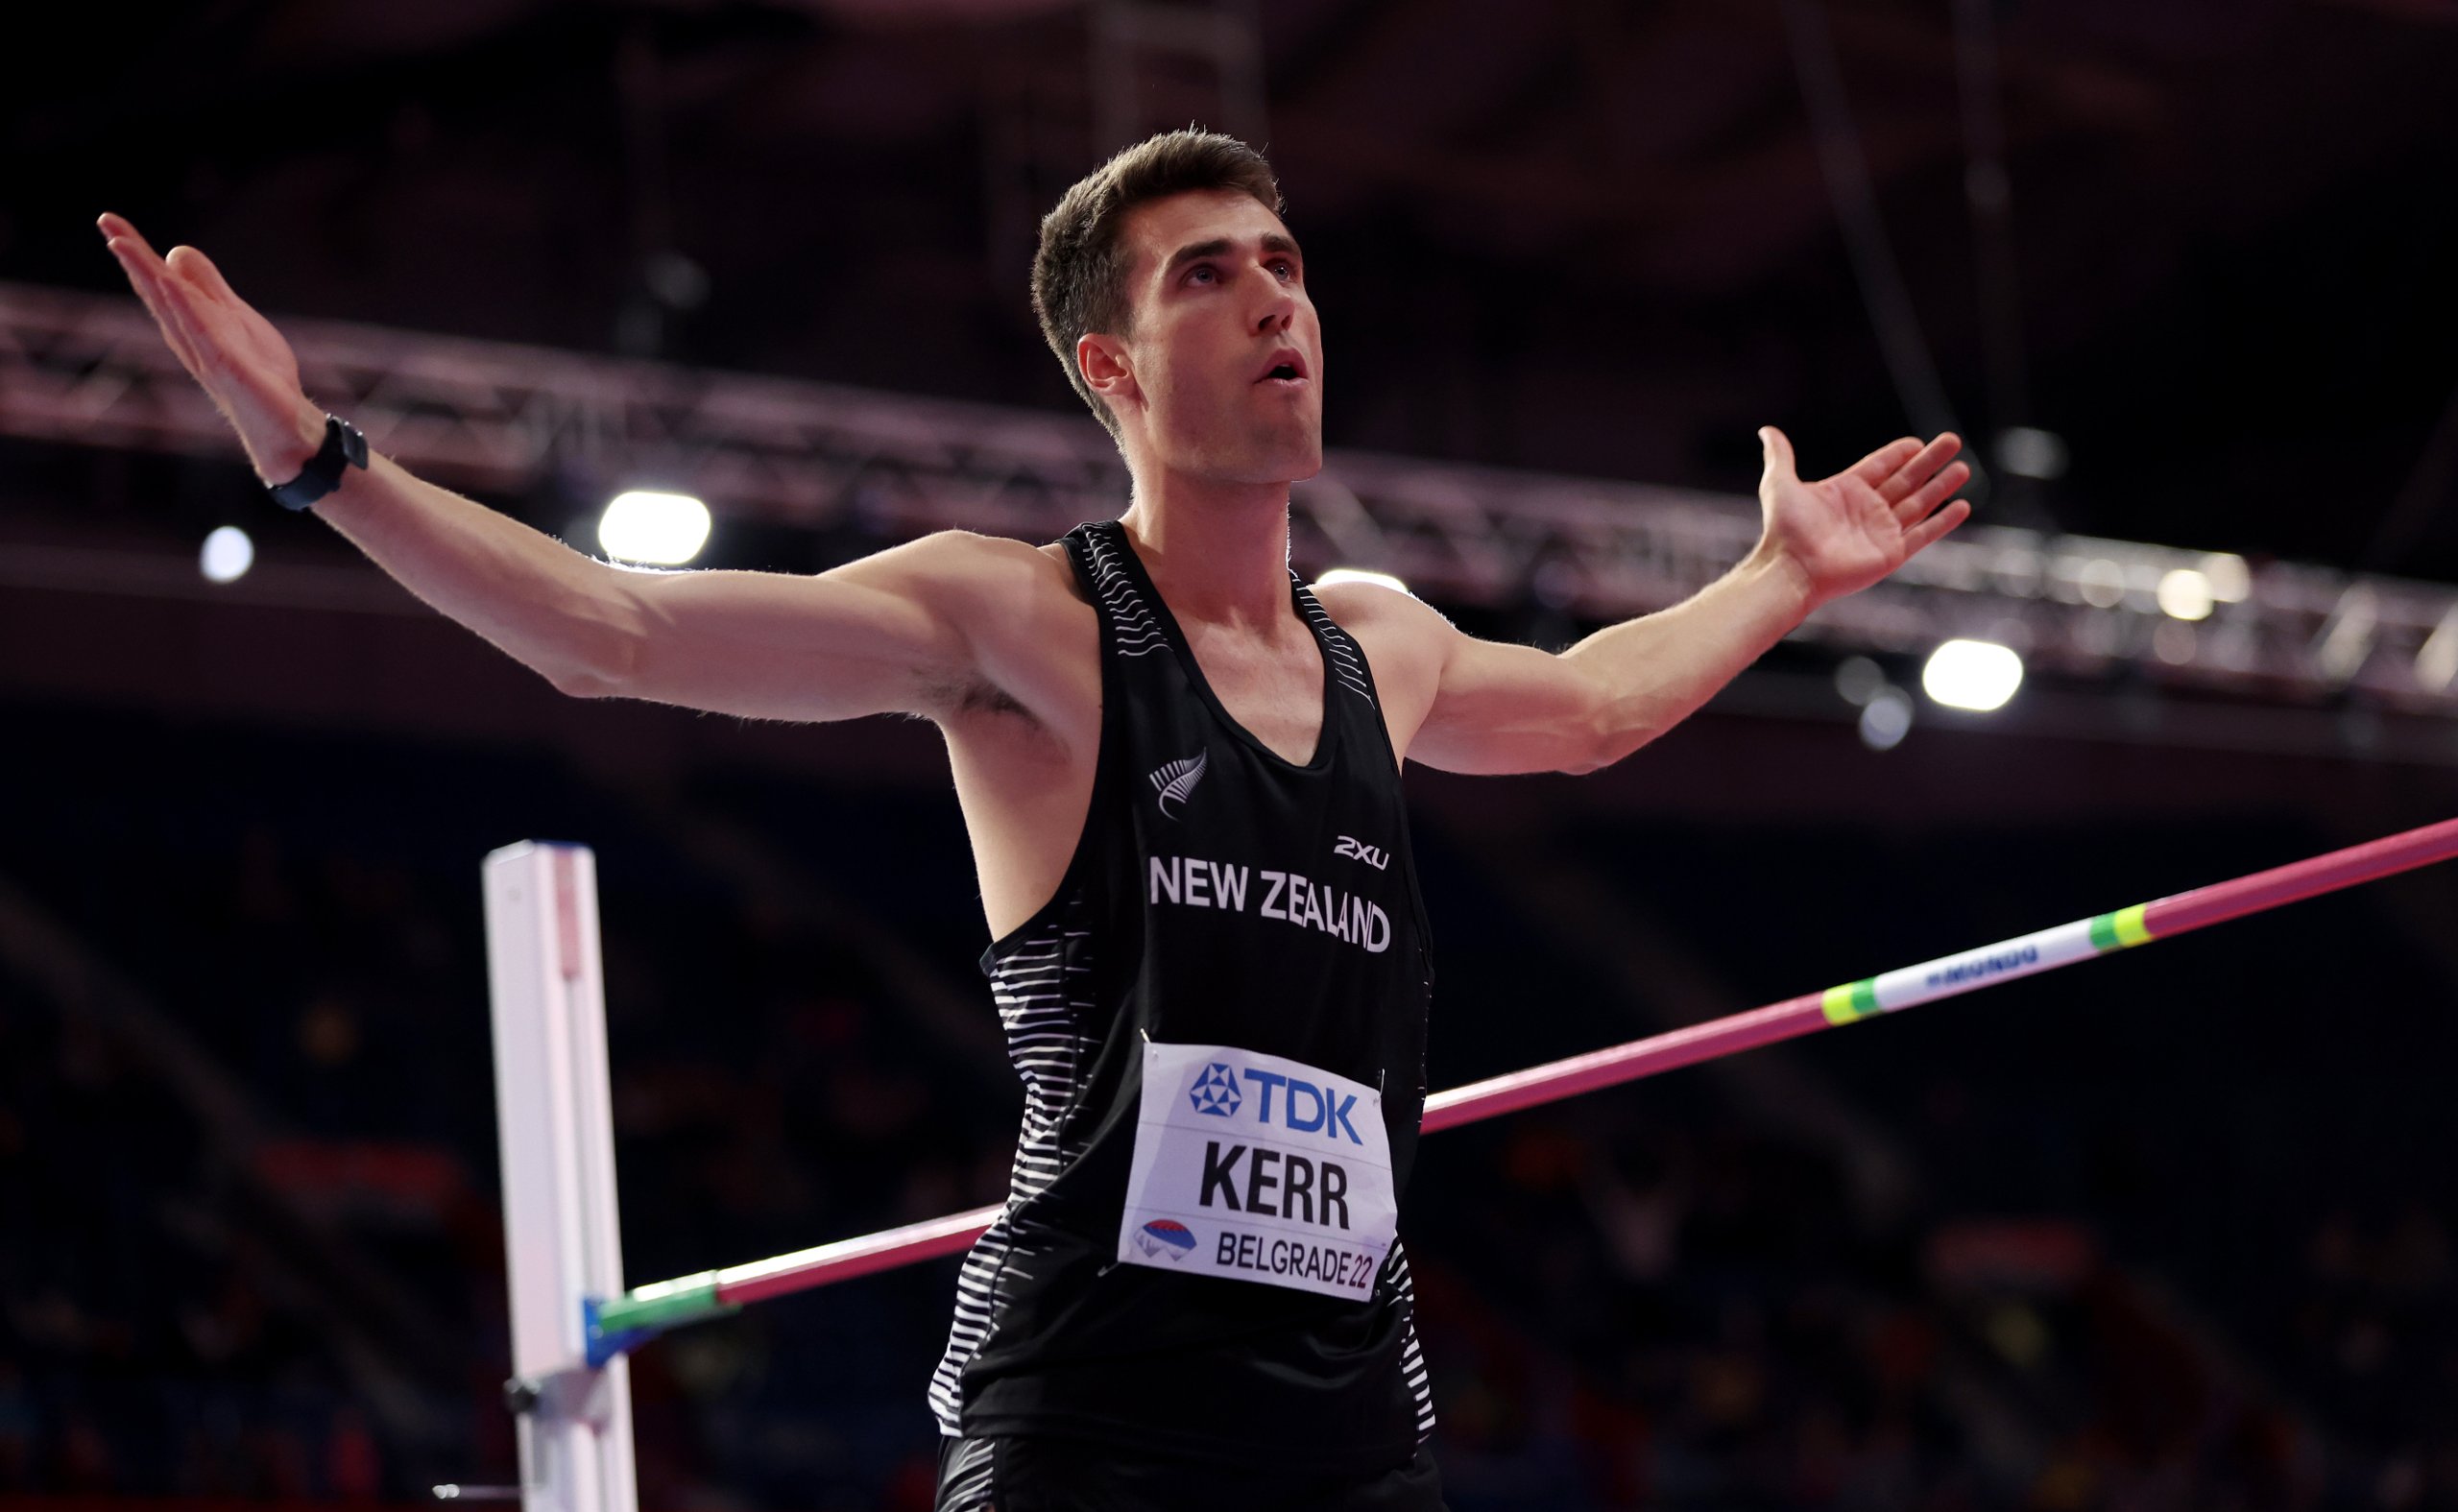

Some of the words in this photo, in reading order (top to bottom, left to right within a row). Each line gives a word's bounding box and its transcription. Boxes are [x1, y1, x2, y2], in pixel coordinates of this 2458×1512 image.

[1334, 835, 1389, 871] 2XU
[1149, 856, 1249, 912] NEW
[1260, 870, 1391, 953] ZEALAND
[1243, 1068, 1363, 1146] TDK
[1199, 1140, 1350, 1231] KERR
